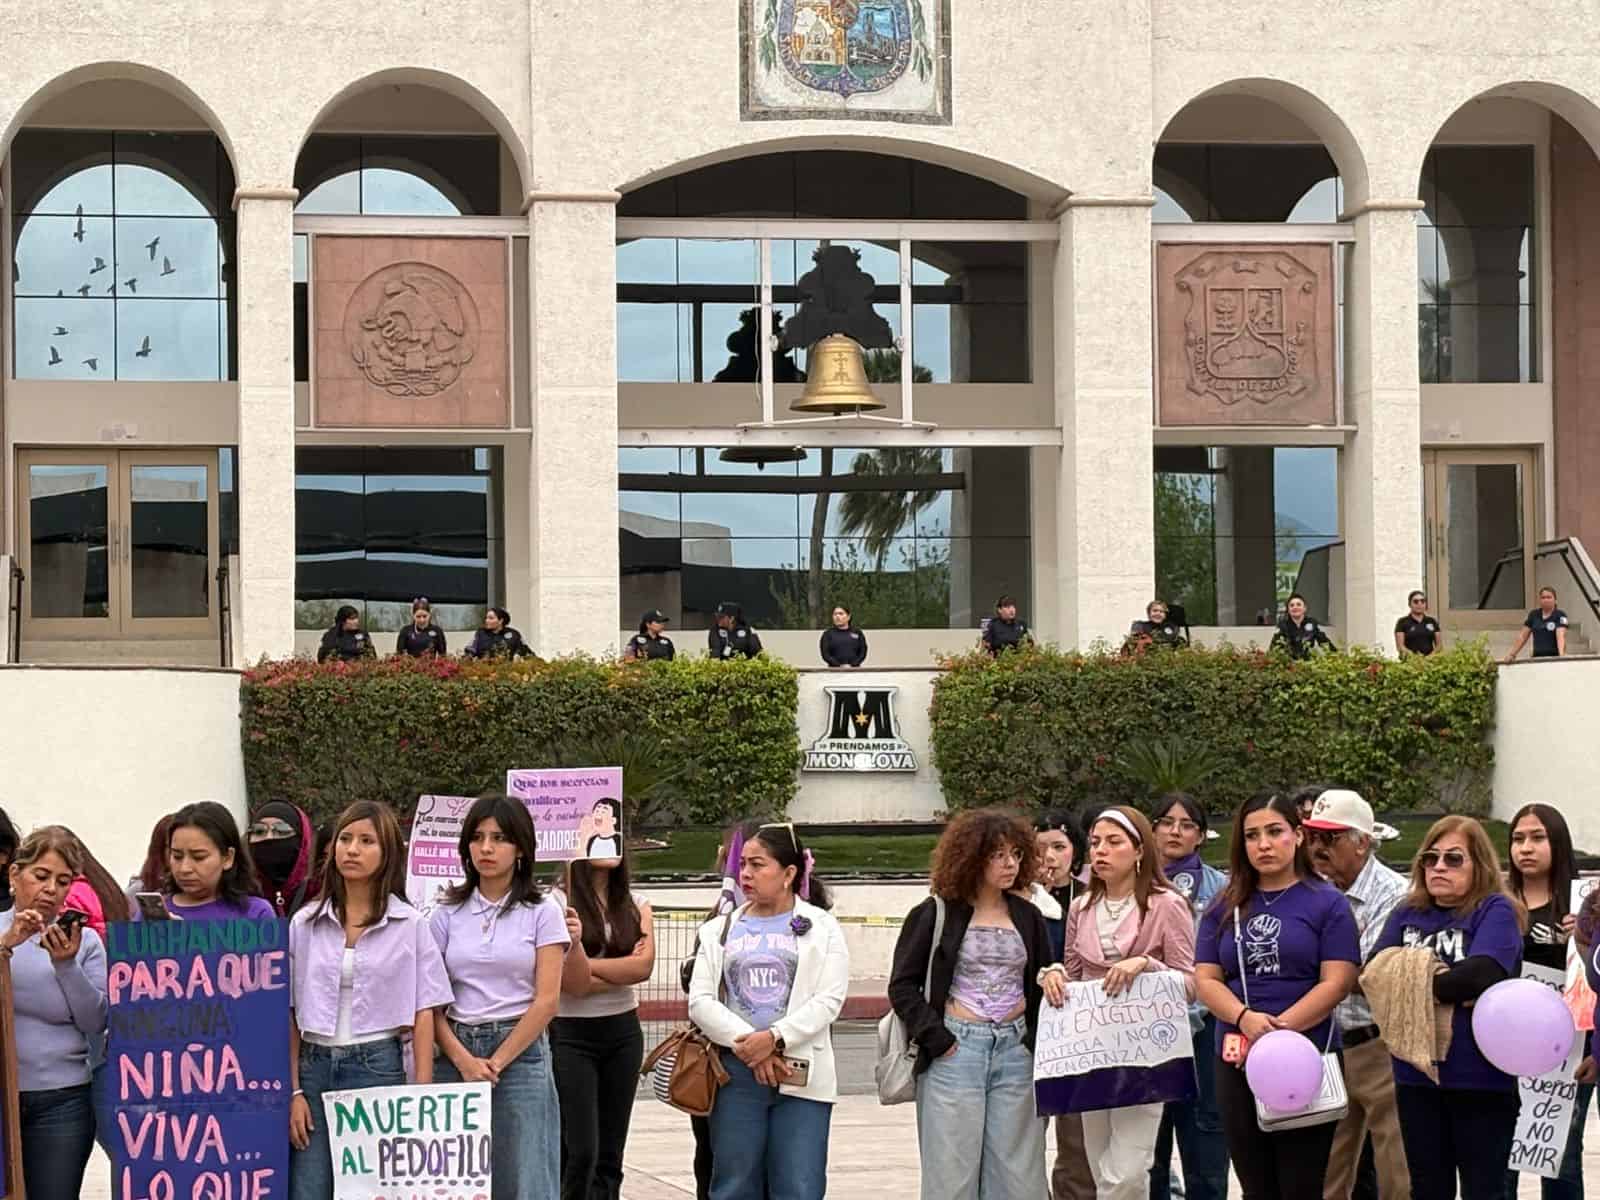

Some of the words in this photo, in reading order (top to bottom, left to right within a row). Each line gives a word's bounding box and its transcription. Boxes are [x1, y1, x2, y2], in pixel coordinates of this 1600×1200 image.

[829, 742, 896, 751] PRENDAMOS
[513, 779, 537, 792] Que
[108, 919, 280, 959] LUCHANDO
[109, 954, 215, 1006] PARA
[218, 951, 287, 998] QUE
[749, 967, 778, 987] NYC
[1126, 1026, 1151, 1043] NO
[1042, 1045, 1147, 1075] VENGANZA
[334, 1092, 481, 1137] MUERTE
[1533, 1097, 1562, 1119] de
[1526, 1122, 1554, 1143] NO
[341, 1145, 375, 1175] AL
[378, 1133, 491, 1180] PEDOFILO
[1511, 1139, 1558, 1172] RMIR
